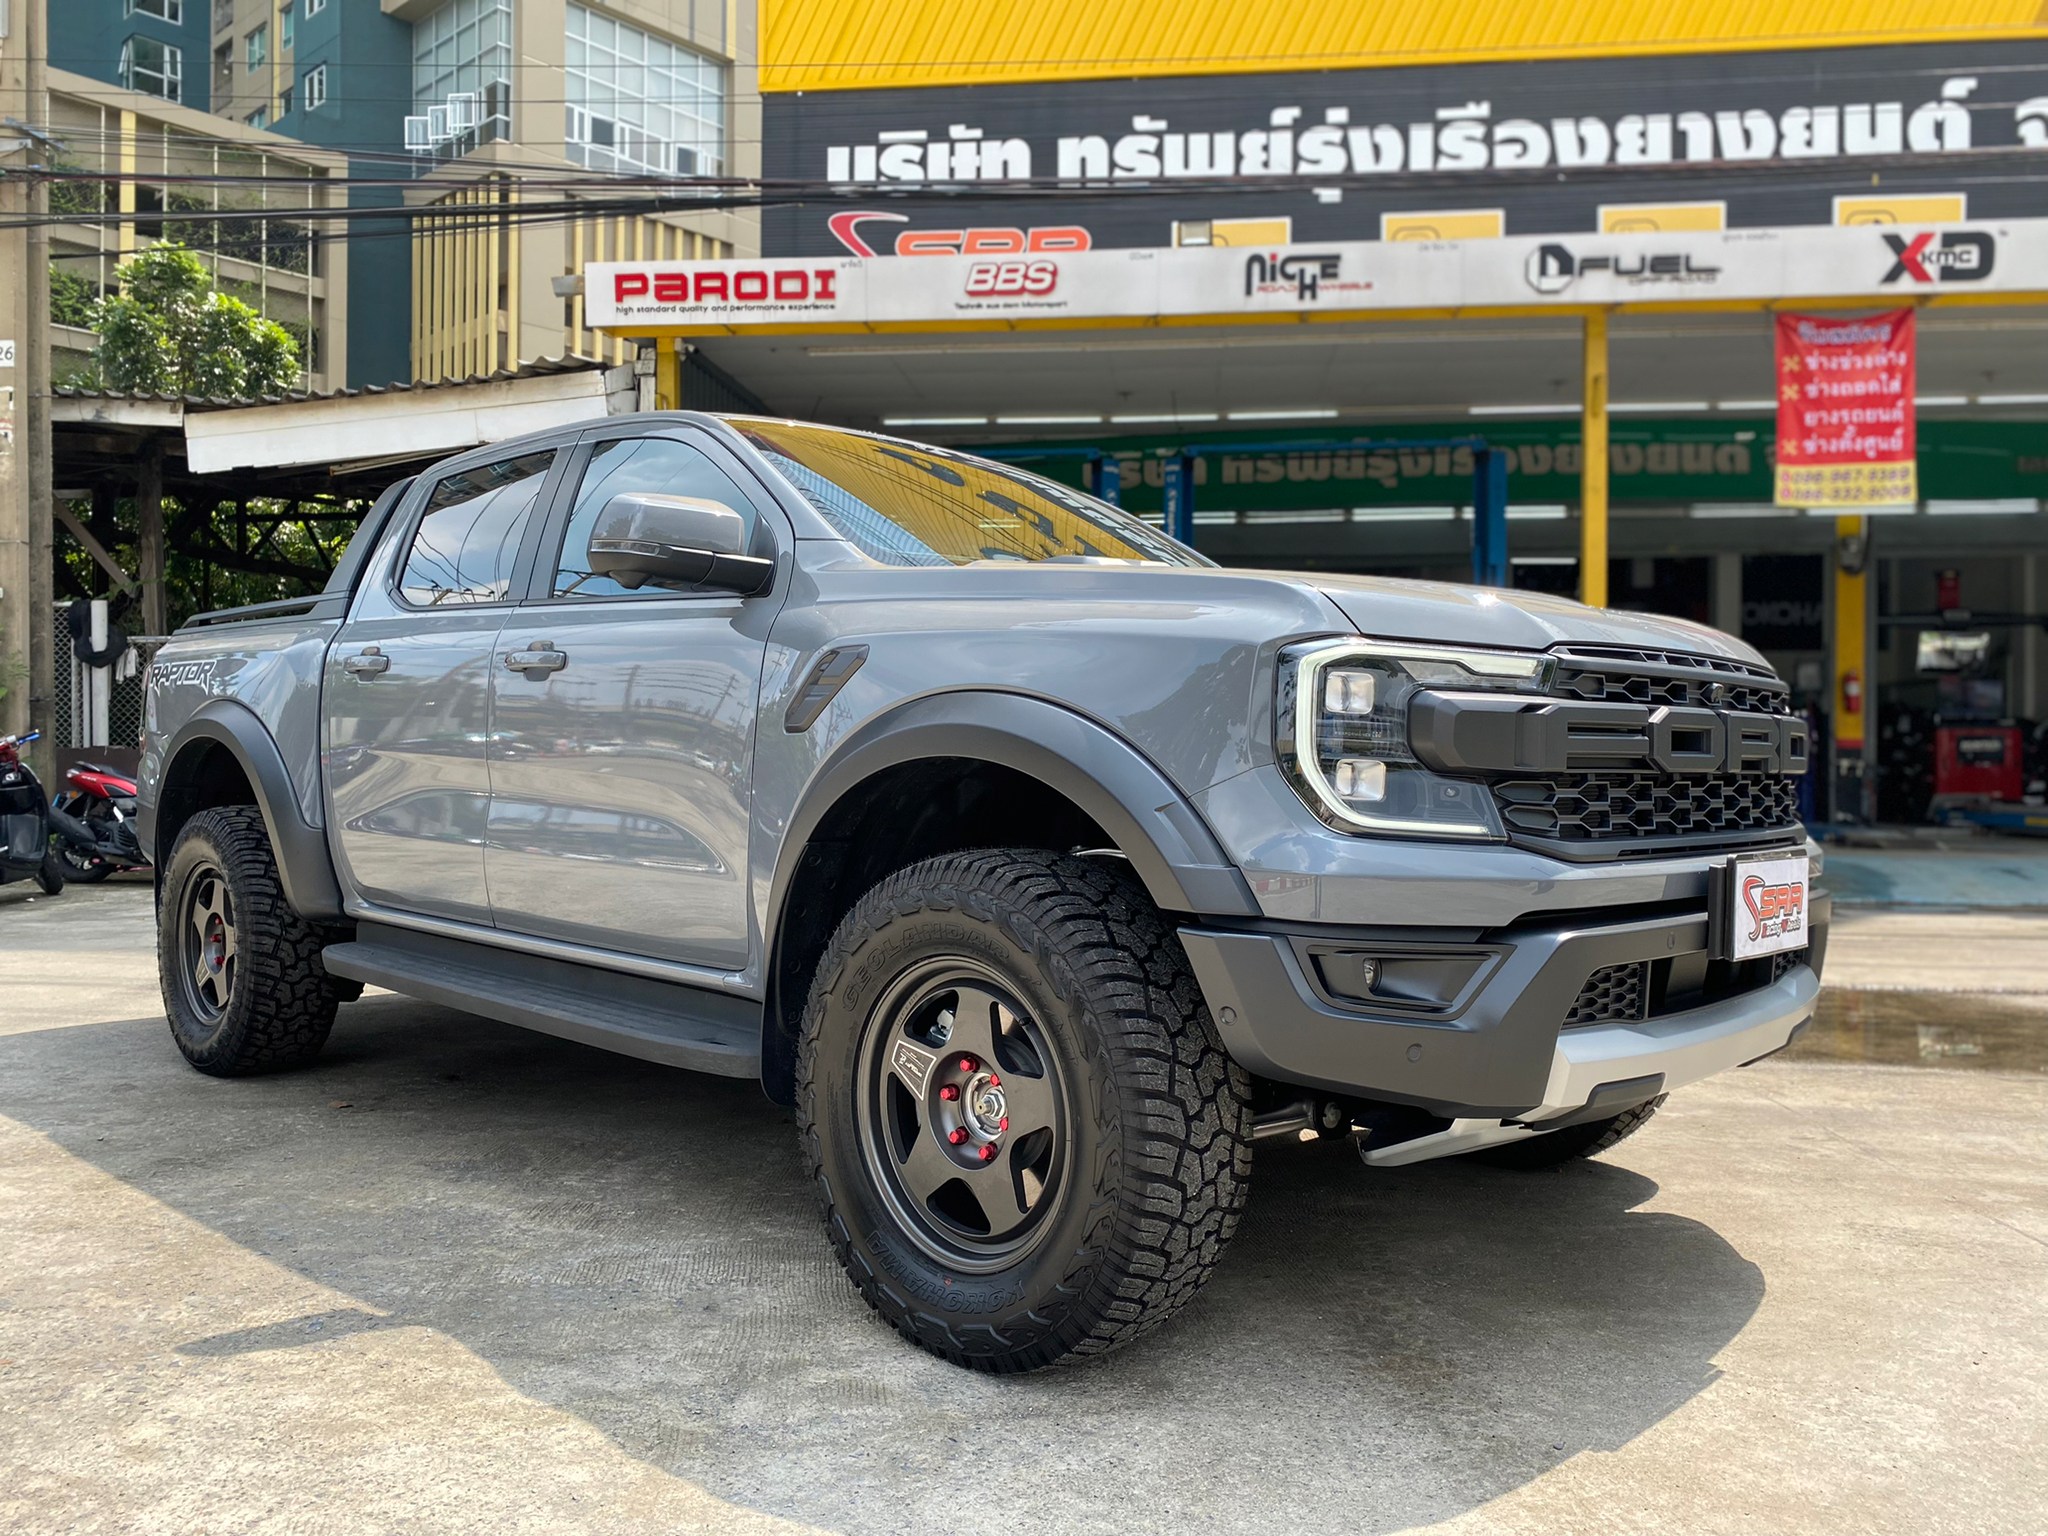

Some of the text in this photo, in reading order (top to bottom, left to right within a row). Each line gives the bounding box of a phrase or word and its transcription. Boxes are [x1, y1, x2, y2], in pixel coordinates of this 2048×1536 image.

[965, 260, 1058, 297] BBS
[1578, 253, 1722, 278] FUEL
[616, 301, 836, 316] high standard quality and performance experience
[1803, 399, 1905, 427] ยางรถยนต์
[150, 660, 217, 697] RAPTOR
[1540, 703, 1808, 775] FORD
[842, 922, 1009, 1012] GEOLANDAR
[866, 1231, 1026, 1315] YOKOHAMA
